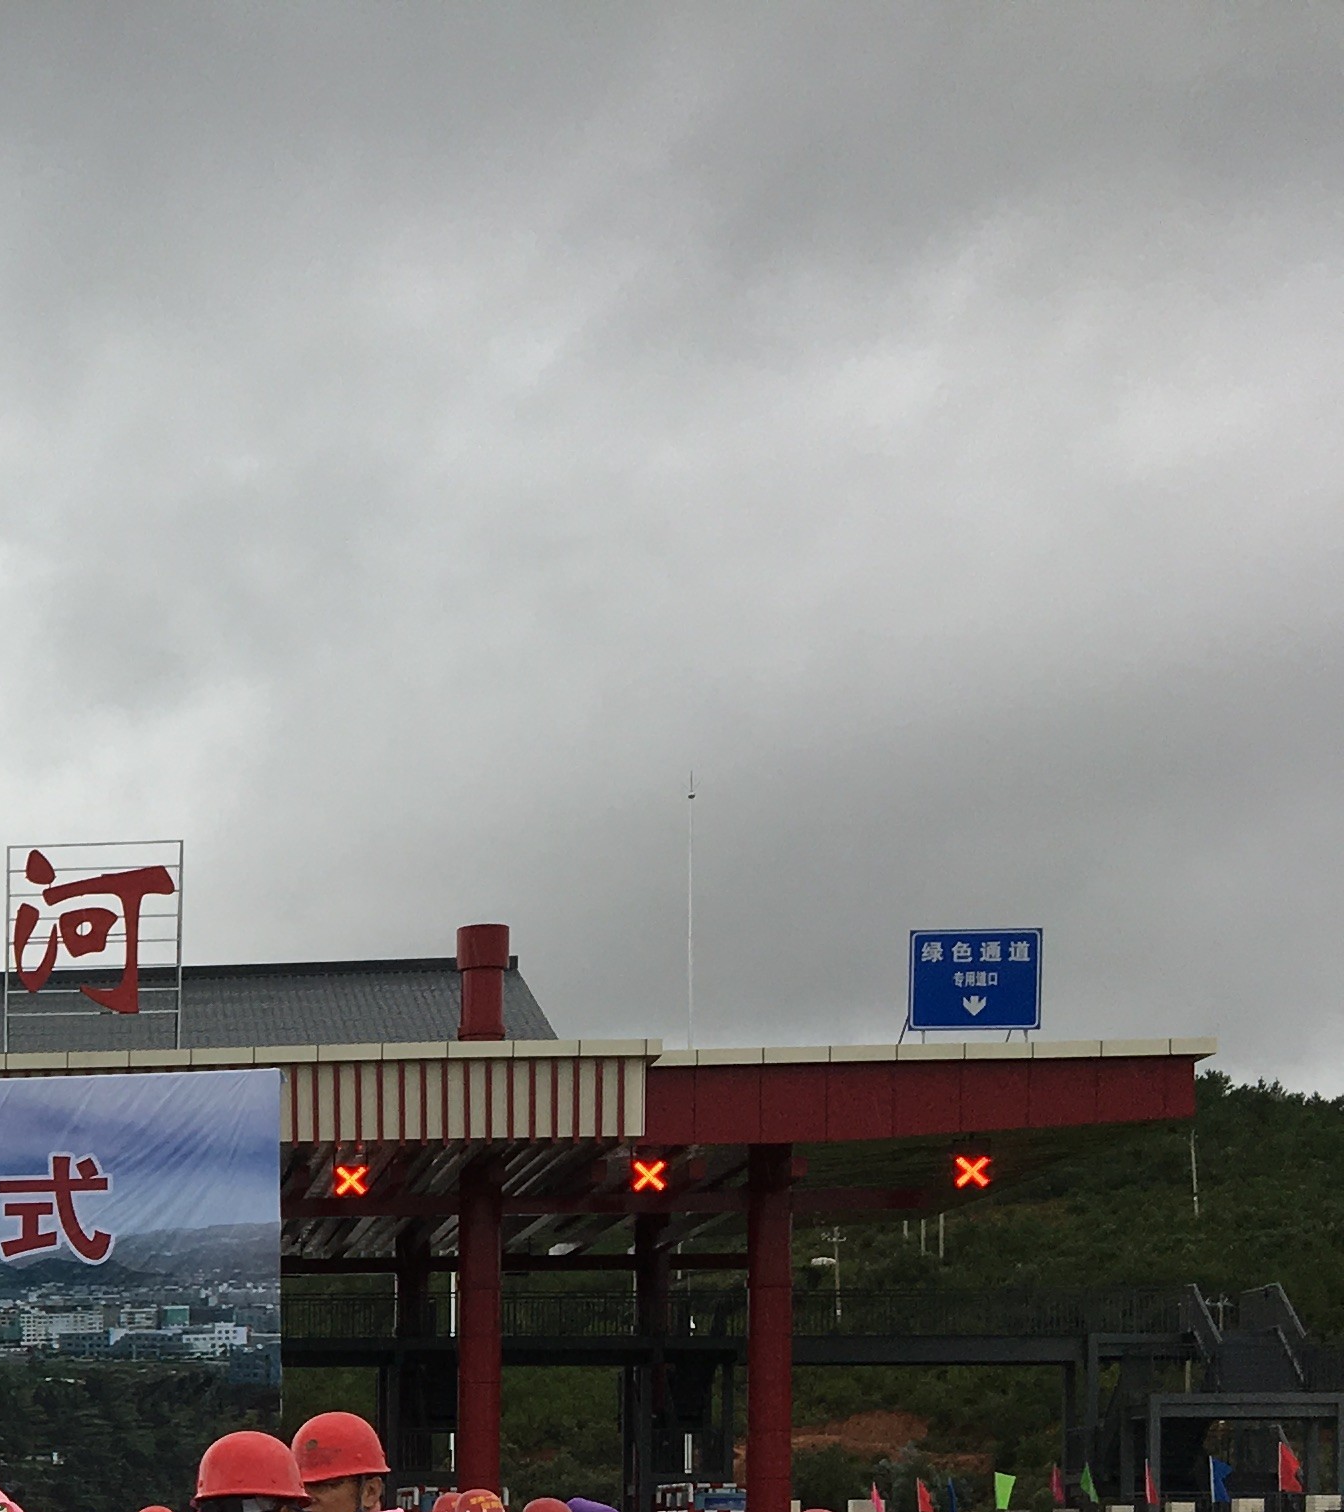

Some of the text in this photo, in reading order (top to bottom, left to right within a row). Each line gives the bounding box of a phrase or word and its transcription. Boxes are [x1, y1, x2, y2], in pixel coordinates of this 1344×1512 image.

[921, 941, 1031, 963] 绿色通道
[953, 971, 998, 987] 专用道口
